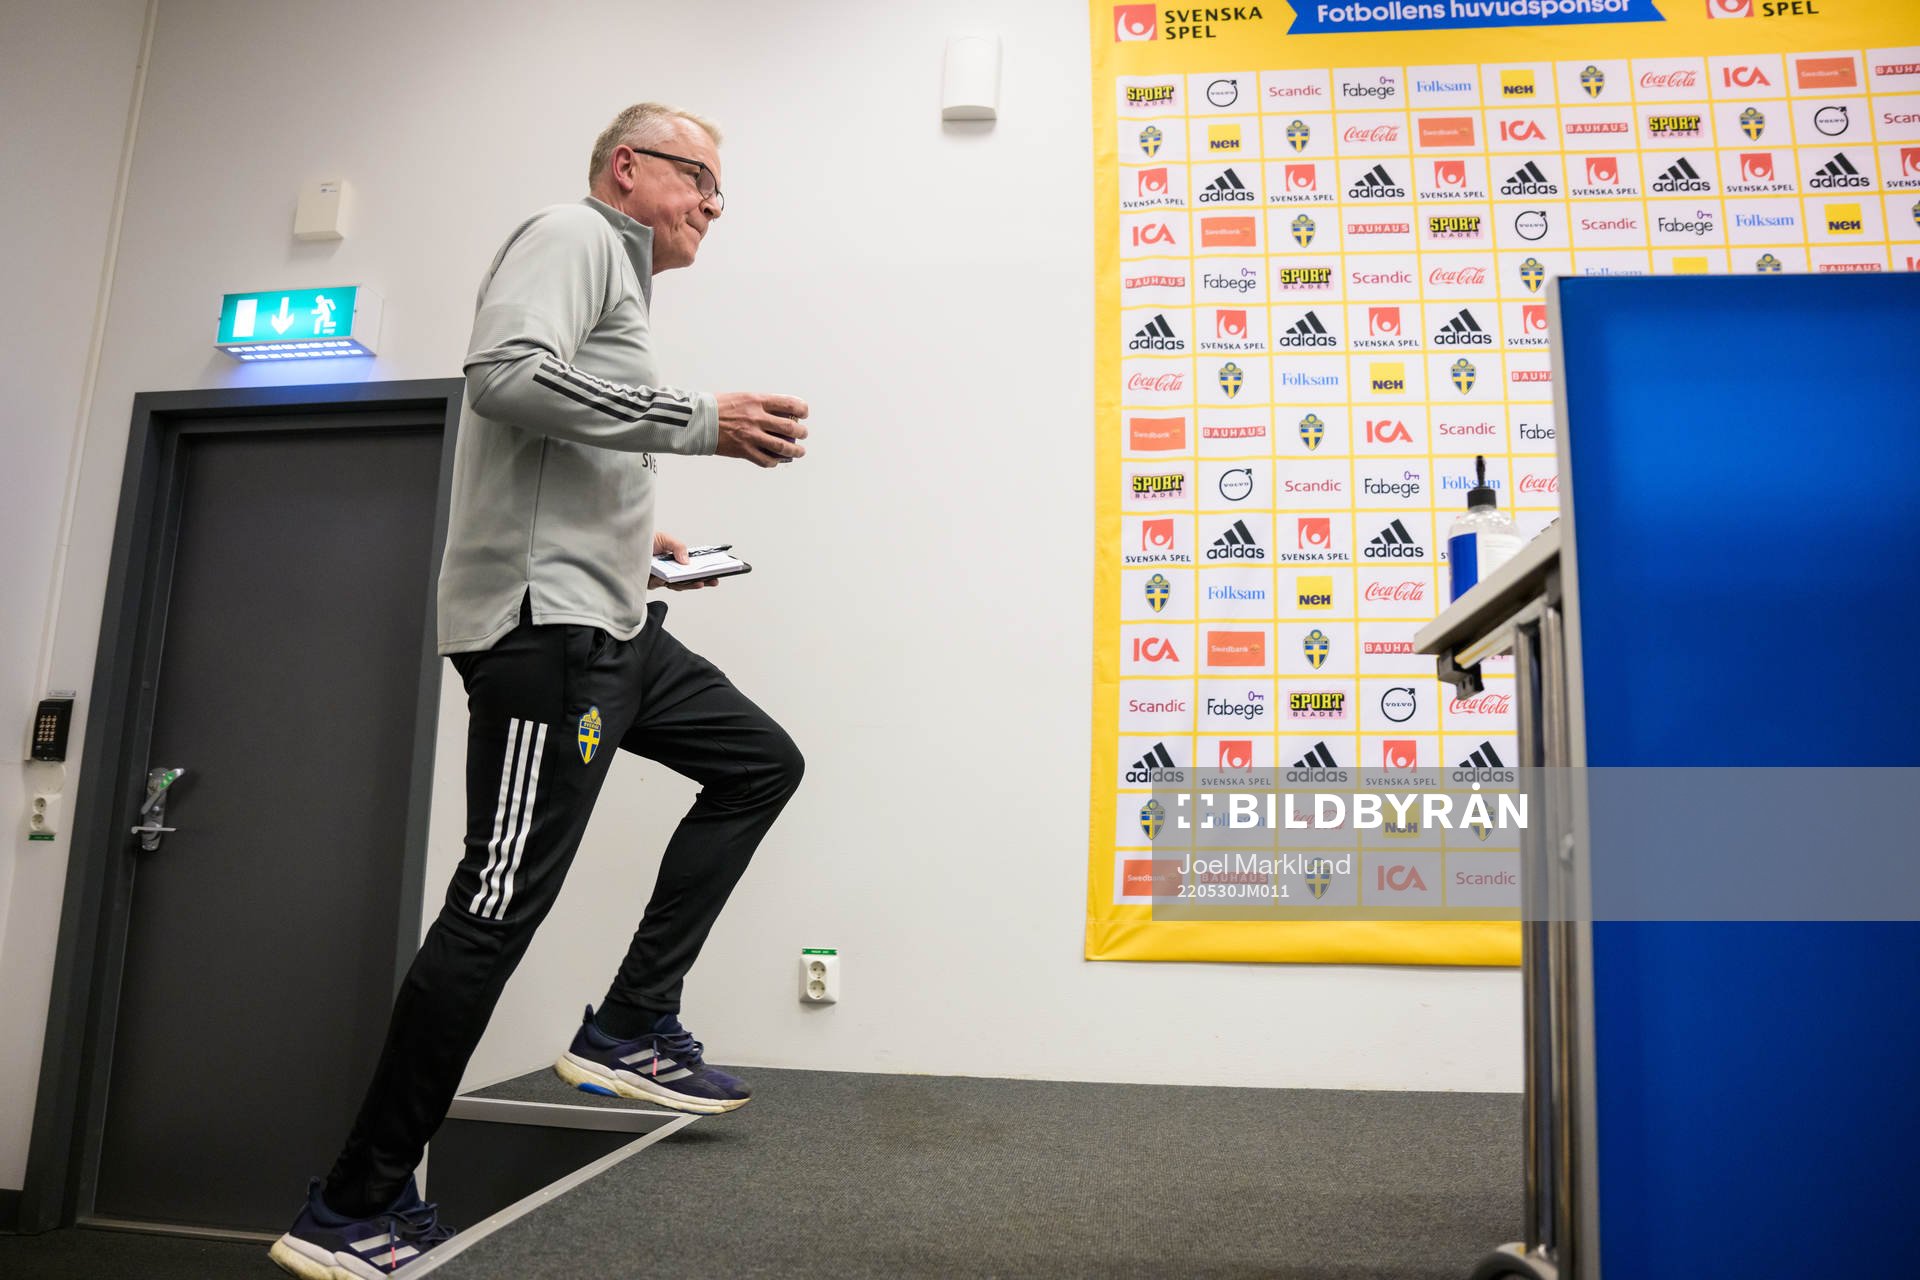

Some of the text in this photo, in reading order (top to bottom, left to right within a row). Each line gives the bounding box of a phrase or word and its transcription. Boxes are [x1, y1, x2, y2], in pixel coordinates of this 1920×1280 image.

[1165, 7, 1263, 24] SVENSKA
[1317, 0, 1630, 23] Fotbollens huvudsponsor
[1762, 0, 1820, 17] SPEL
[1166, 26, 1217, 40] SPEL
[1723, 66, 1772, 88] ICA
[1127, 85, 1176, 102] SPORT
[1269, 85, 1323, 98] Scandic
[1343, 83, 1395, 100] Fabege
[1416, 80, 1472, 93] Folksam
[1500, 120, 1547, 141] ICA
[1567, 123, 1628, 133] BAUHAUS
[1649, 115, 1700, 132] SPORT
[1652, 178, 1711, 192] adidas
[1726, 184, 1794, 193] SVENSKA SPEL
[1809, 174, 1870, 189] adidas
[1349, 186, 1405, 199] adidas
[1420, 191, 1461, 200] SVENSKA
[1500, 182, 1558, 196] adidas
[1572, 188, 1614, 196] SVENSKA
[1123, 198, 1185, 209] SVENSKA SPEL
[1199, 190, 1255, 203] adidas
[1270, 194, 1334, 204] SVENSKA SPEL
[1429, 216, 1480, 233] SPORT
[1582, 218, 1638, 231] Scandic
[1658, 217, 1713, 236] Fabege
[1736, 214, 1795, 227] Folksam
[1132, 223, 1177, 247] ICA
[1349, 224, 1409, 234] BAUHAUS
[1126, 276, 1185, 288] BAUHAUS
[1203, 274, 1257, 293] Fabege
[1280, 268, 1331, 285] SPORT
[1352, 271, 1413, 285] Scandic
[1129, 337, 1185, 351] adidas
[1280, 333, 1337, 347] adidas
[1353, 339, 1419, 348] SVENSKA SPEL
[1434, 331, 1493, 345] adidas
[1200, 342, 1265, 350] SVENSKA SPEL
[1282, 372, 1339, 386] Folksam
[1204, 426, 1265, 438] BAUHAUS
[1366, 420, 1413, 444] ICA
[1439, 423, 1497, 435] Scandic
[1520, 424, 1556, 440] Fabe
[1132, 474, 1184, 493] SPORT
[1284, 480, 1342, 492] Scandic
[1364, 478, 1420, 499] Fabege
[1441, 476, 1501, 490] Folksm
[1135, 491, 1183, 499] BLADET
[1206, 546, 1265, 560] adidas
[1281, 552, 1350, 561] SVENSKA SPEL
[1364, 544, 1424, 558] adidas
[1125, 554, 1191, 564] SVENSKA SPEL
[1208, 586, 1266, 600] Folksam
[1133, 637, 1180, 663] ICA
[1129, 699, 1186, 713] Scandic
[1207, 698, 1264, 720] Fabege
[1290, 693, 1345, 711] SPORT
[1126, 768, 1184, 783] adidas
[1201, 778, 1271, 786] SVENSKA SPEL
[1287, 768, 1348, 783] adidas
[1366, 778, 1437, 786] SVENSKA SPEL
[1452, 768, 1515, 783] adidas
[1127, 874, 1166, 882] Swedbank
[1202, 872, 1268, 883] BAUHAUS
[1377, 865, 1428, 891] ICA
[1456, 872, 1516, 886] Scandic
